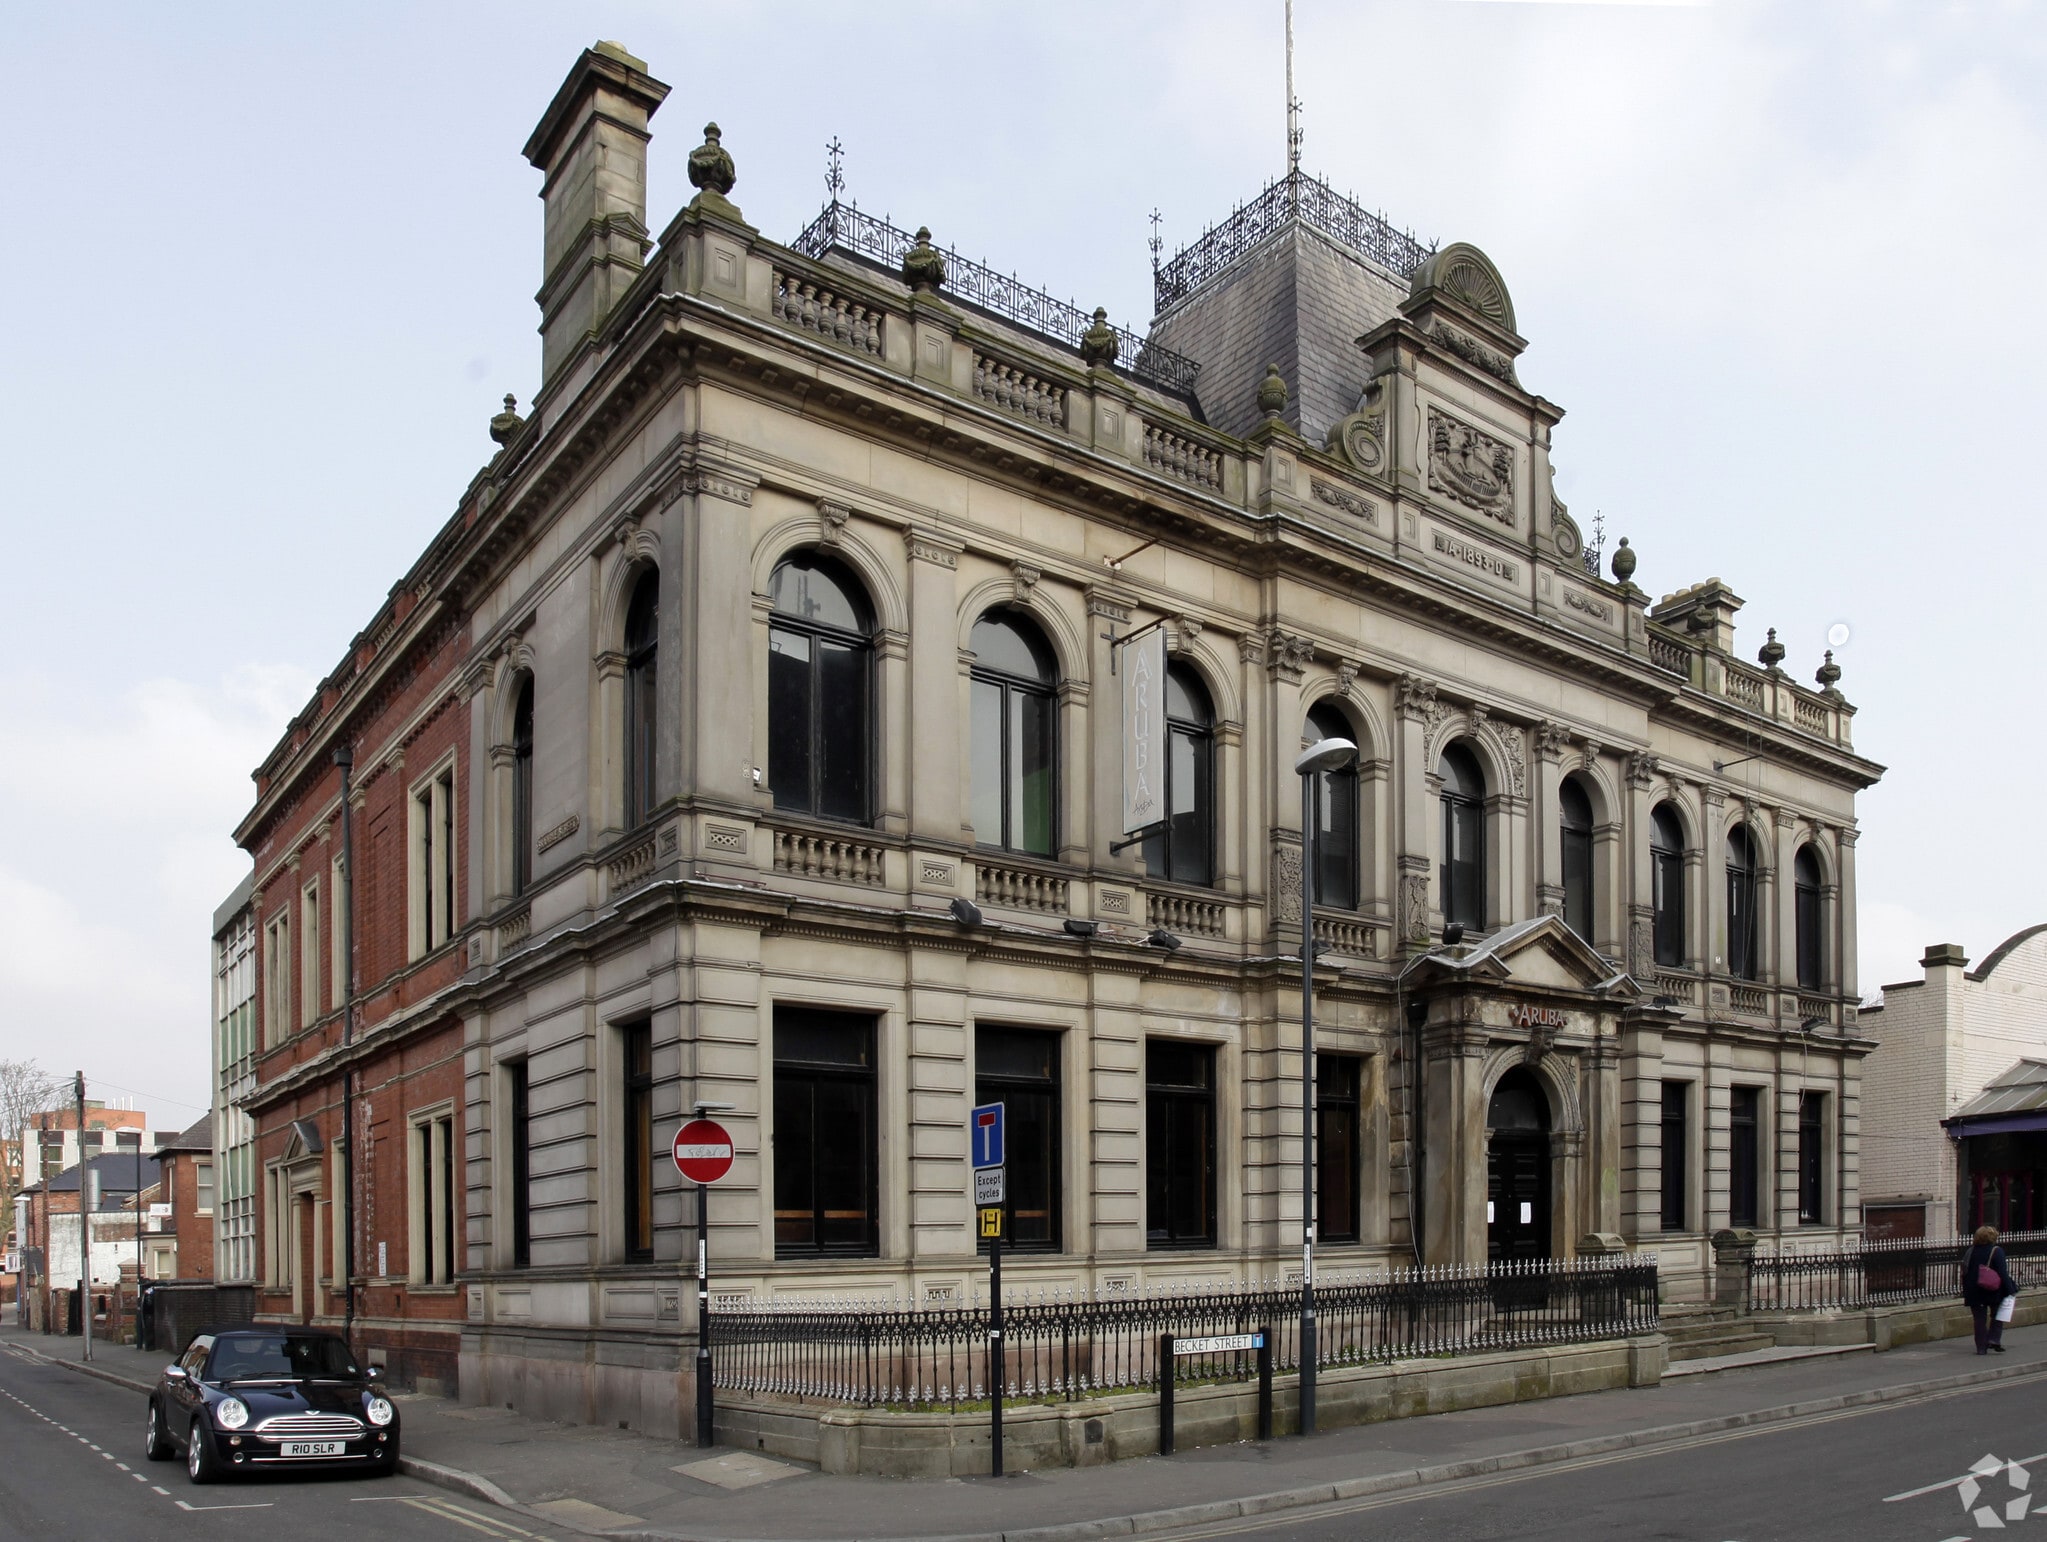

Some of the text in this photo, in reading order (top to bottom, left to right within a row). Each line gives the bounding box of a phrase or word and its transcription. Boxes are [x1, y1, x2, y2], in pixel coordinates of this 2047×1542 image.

[1132, 647, 1152, 800] ARUBA
[1519, 1003, 1565, 1027] ARUBA
[977, 1174, 1001, 1186] Except
[978, 1188, 1000, 1200] cycles
[983, 1211, 998, 1234] H
[1174, 1336, 1248, 1353] BECKET STREET
[313, 1443, 335, 1454] SLR
